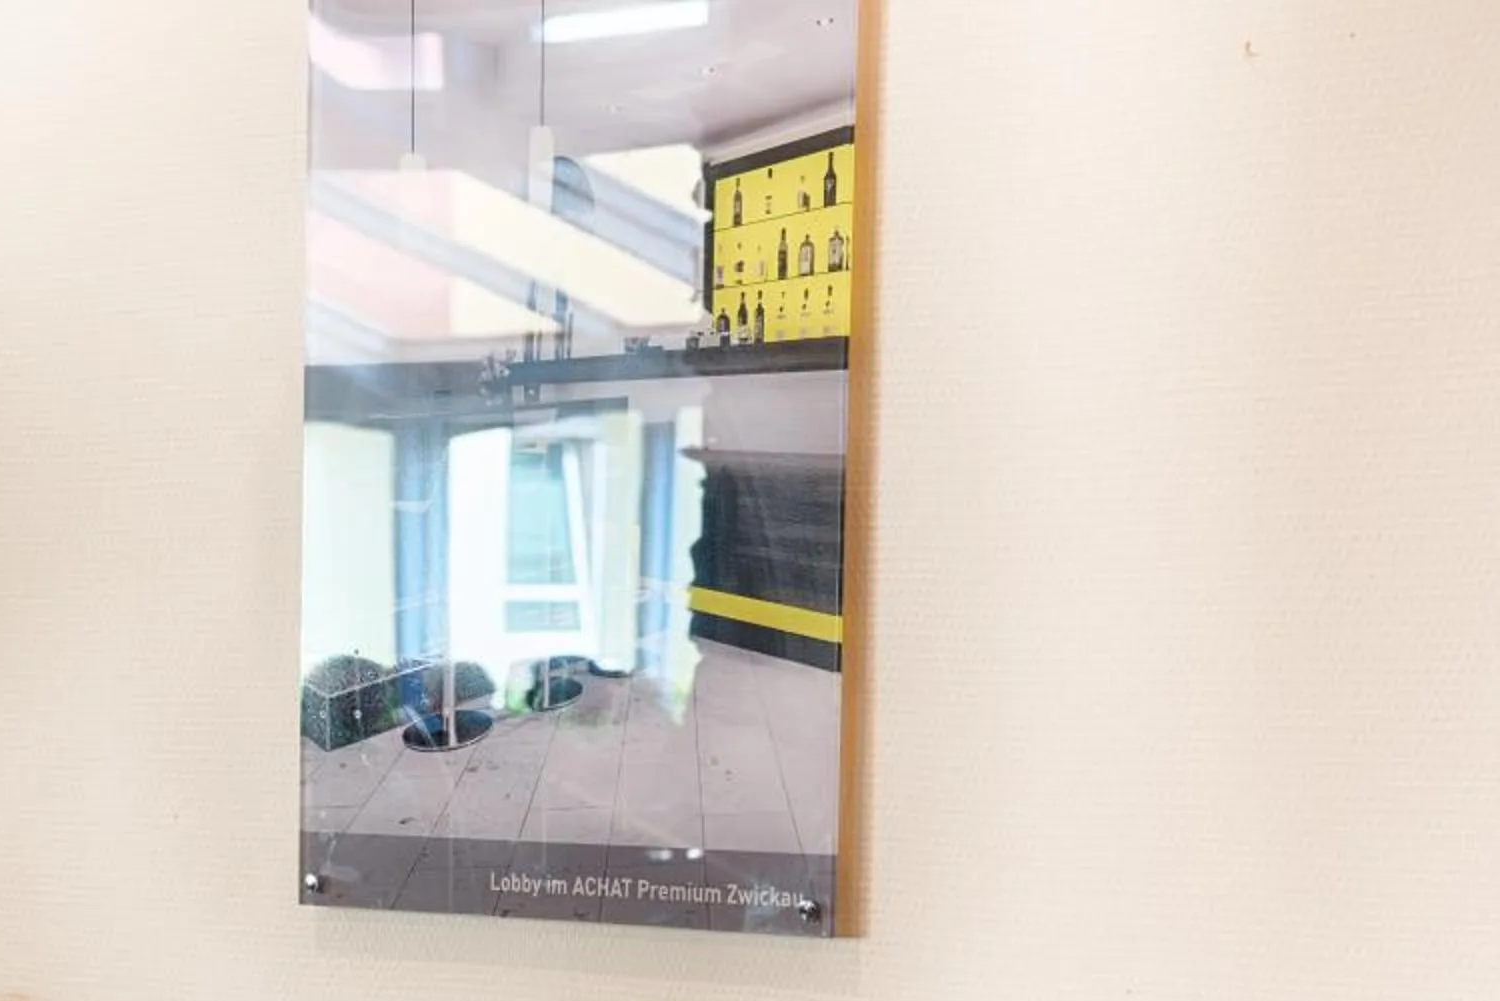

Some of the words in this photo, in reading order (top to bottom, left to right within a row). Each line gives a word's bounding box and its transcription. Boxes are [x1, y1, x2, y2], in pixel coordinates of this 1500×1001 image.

[489, 871, 542, 897] Lobby
[546, 874, 568, 895] im
[572, 876, 633, 898] ACHAT
[637, 879, 722, 904] Premium
[726, 883, 805, 908] Zwickau
